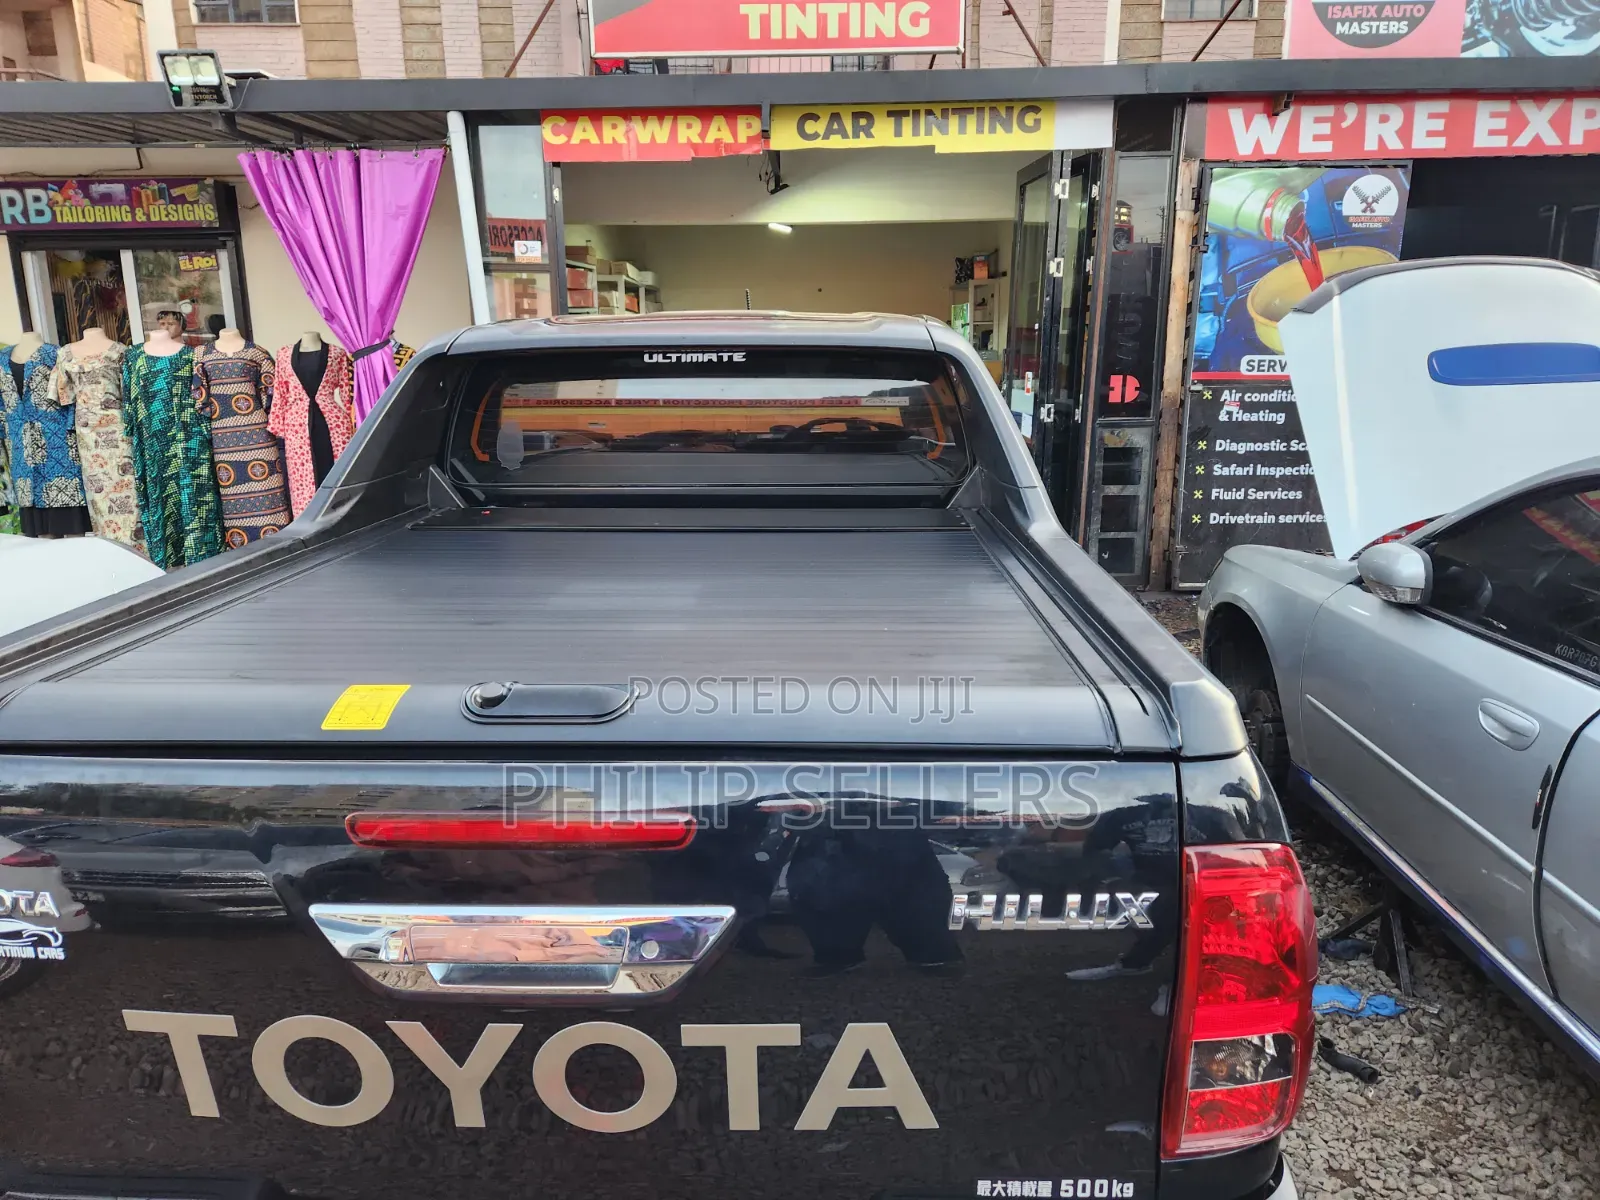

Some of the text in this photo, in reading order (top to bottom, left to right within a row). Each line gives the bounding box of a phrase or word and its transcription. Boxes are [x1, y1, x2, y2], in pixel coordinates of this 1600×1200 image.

[1327, 5, 1426, 19] ISAFIX AUTO
[740, 1, 931, 40] TINTING
[1336, 21, 1409, 35] MASTERS
[541, 114, 762, 145] CARWRAP
[796, 104, 1042, 142] CAR TINTING
[1473, 98, 1600, 149] EXP
[53, 205, 132, 223] TAILORING
[135, 207, 146, 222] &
[150, 203, 216, 222] DESIGNS
[643, 352, 747, 363] ULTIMATE
[1220, 389, 1242, 402] Air
[1218, 409, 1286, 424] & Heating
[1215, 440, 1287, 454] Diagnostic
[1212, 464, 1253, 476] Safari
[1211, 488, 1303, 501] Fluid Services
[1209, 512, 1275, 525] Drivetrain
[948, 892, 1161, 931] HILUX
[37, 946, 66, 960] CARS
[122, 1008, 940, 1134] TOYOTA
[976, 1179, 1053, 1198] 最大積載量
